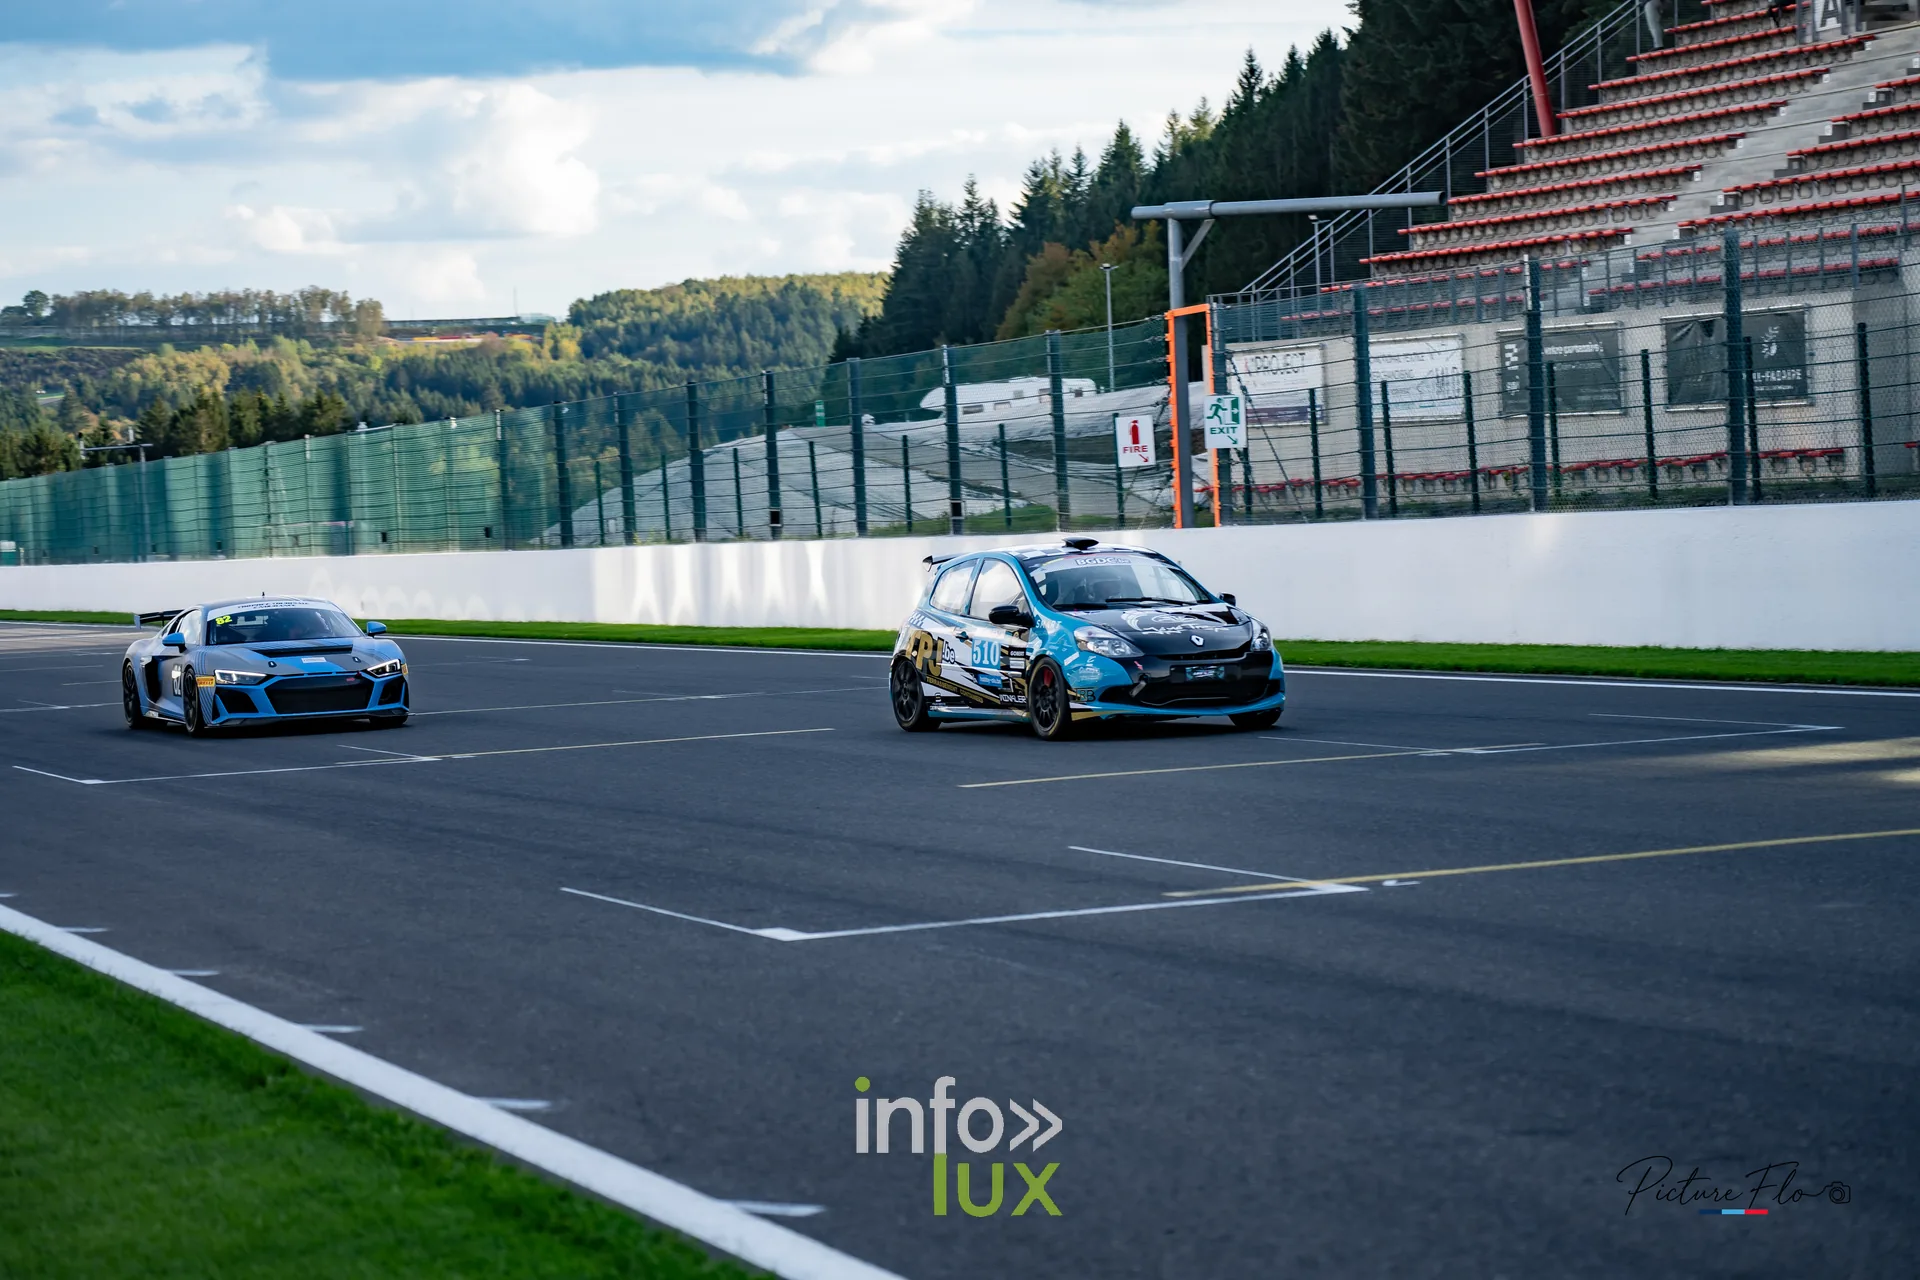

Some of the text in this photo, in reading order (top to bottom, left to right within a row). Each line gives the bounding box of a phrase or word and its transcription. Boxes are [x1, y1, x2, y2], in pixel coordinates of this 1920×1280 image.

[1123, 445, 1148, 453] FIRE
[215, 615, 232, 625] 82
[972, 640, 1000, 666] 510
